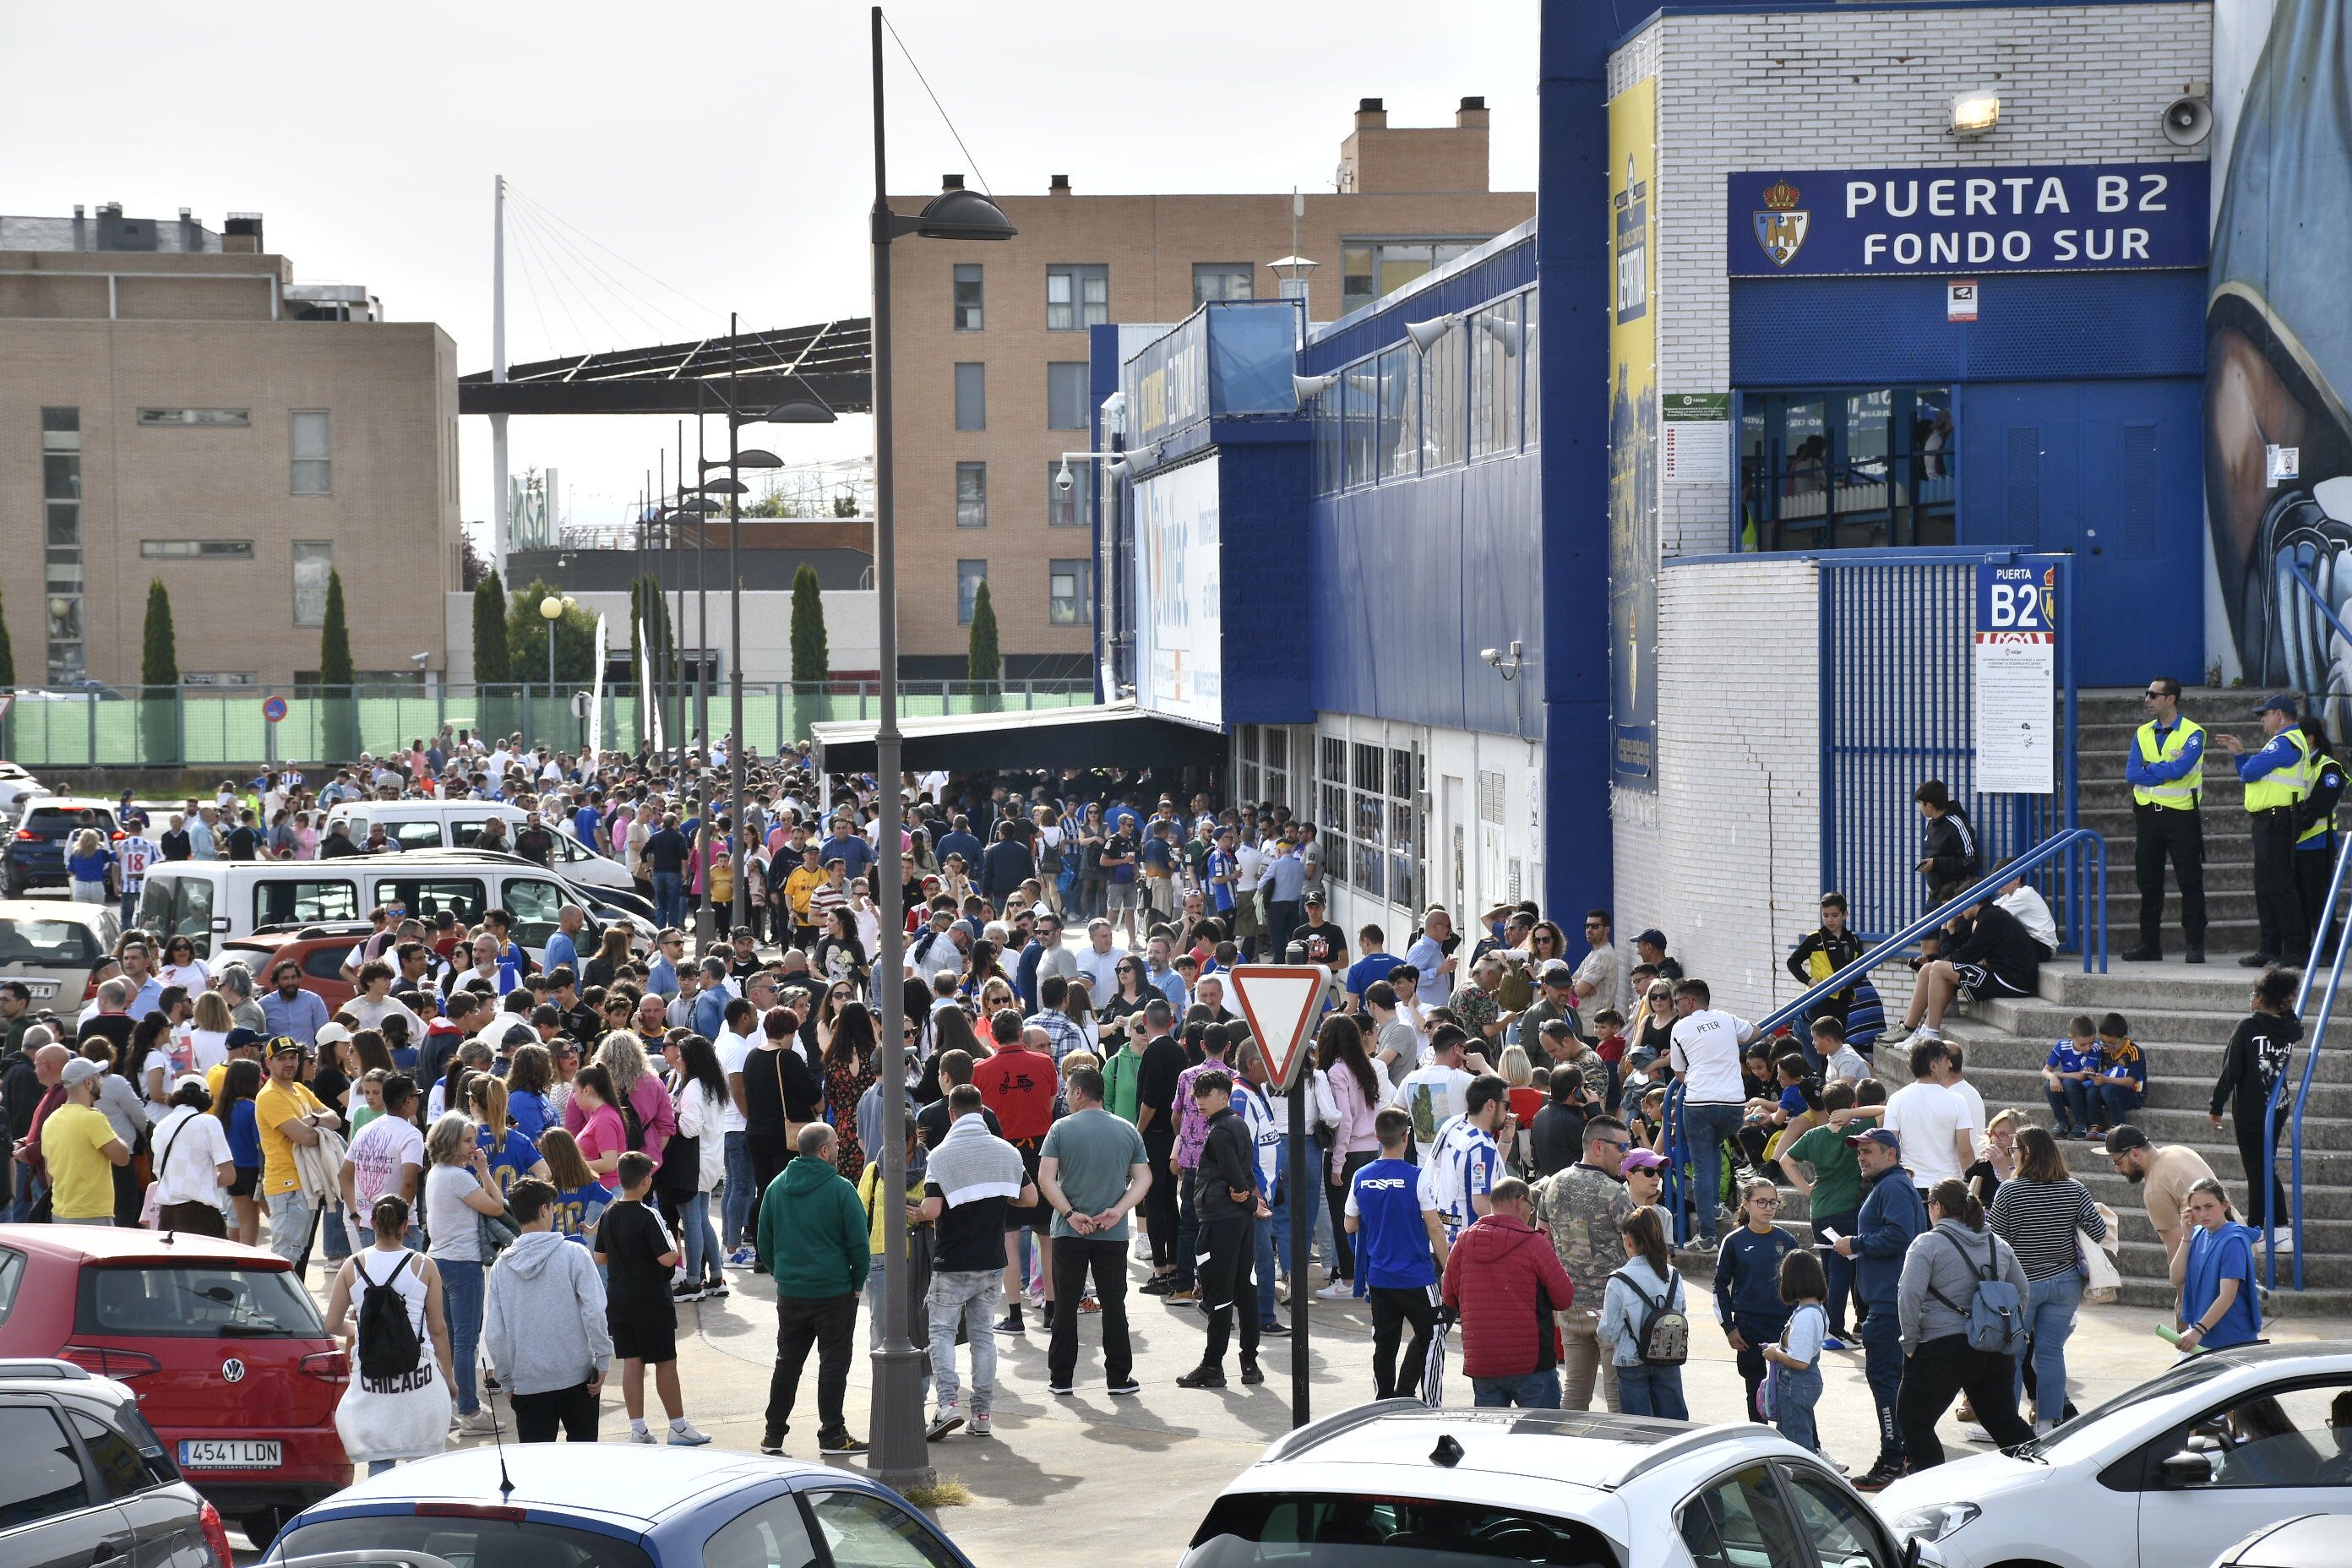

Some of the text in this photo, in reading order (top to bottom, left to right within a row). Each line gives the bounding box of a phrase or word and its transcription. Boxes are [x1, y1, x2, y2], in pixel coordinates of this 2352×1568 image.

[1847, 175, 2167, 217] PUERTA B2
[1865, 228, 2148, 264] FONDO SUR
[1618, 246, 1645, 312] DEPORTIVA
[1997, 569, 2031, 579] PUERTA
[1992, 585, 2037, 626] B2
[128, 853, 145, 872] 18
[1696, 1021, 1721, 1033] PETER
[361, 1363, 433, 1394] CHICAGO
[1882, 1407, 1895, 1440] joma
[193, 1443, 277, 1462] 4541 LDN
